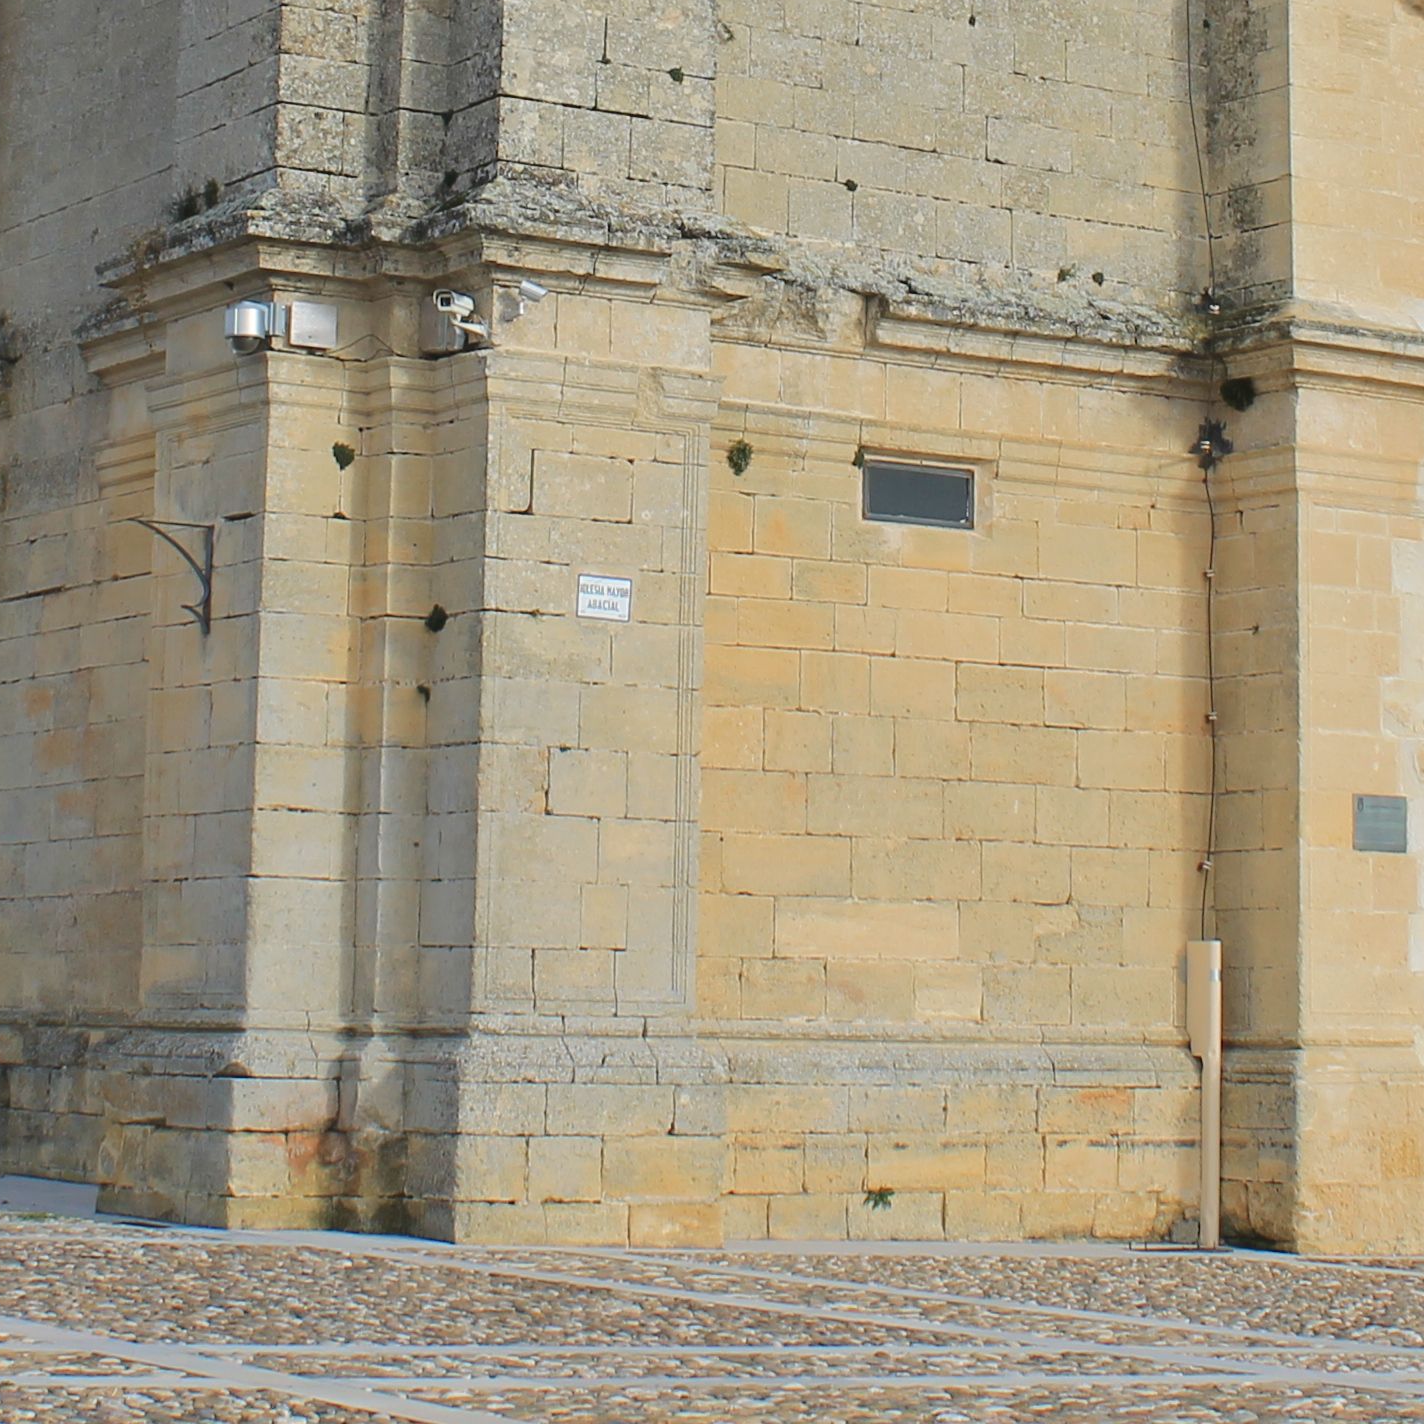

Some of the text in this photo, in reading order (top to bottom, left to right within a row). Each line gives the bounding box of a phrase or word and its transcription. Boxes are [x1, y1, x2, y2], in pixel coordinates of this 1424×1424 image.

[580, 583, 629, 598] IGLESIA MAYOR
[587, 599, 619, 612] ABACIAL
